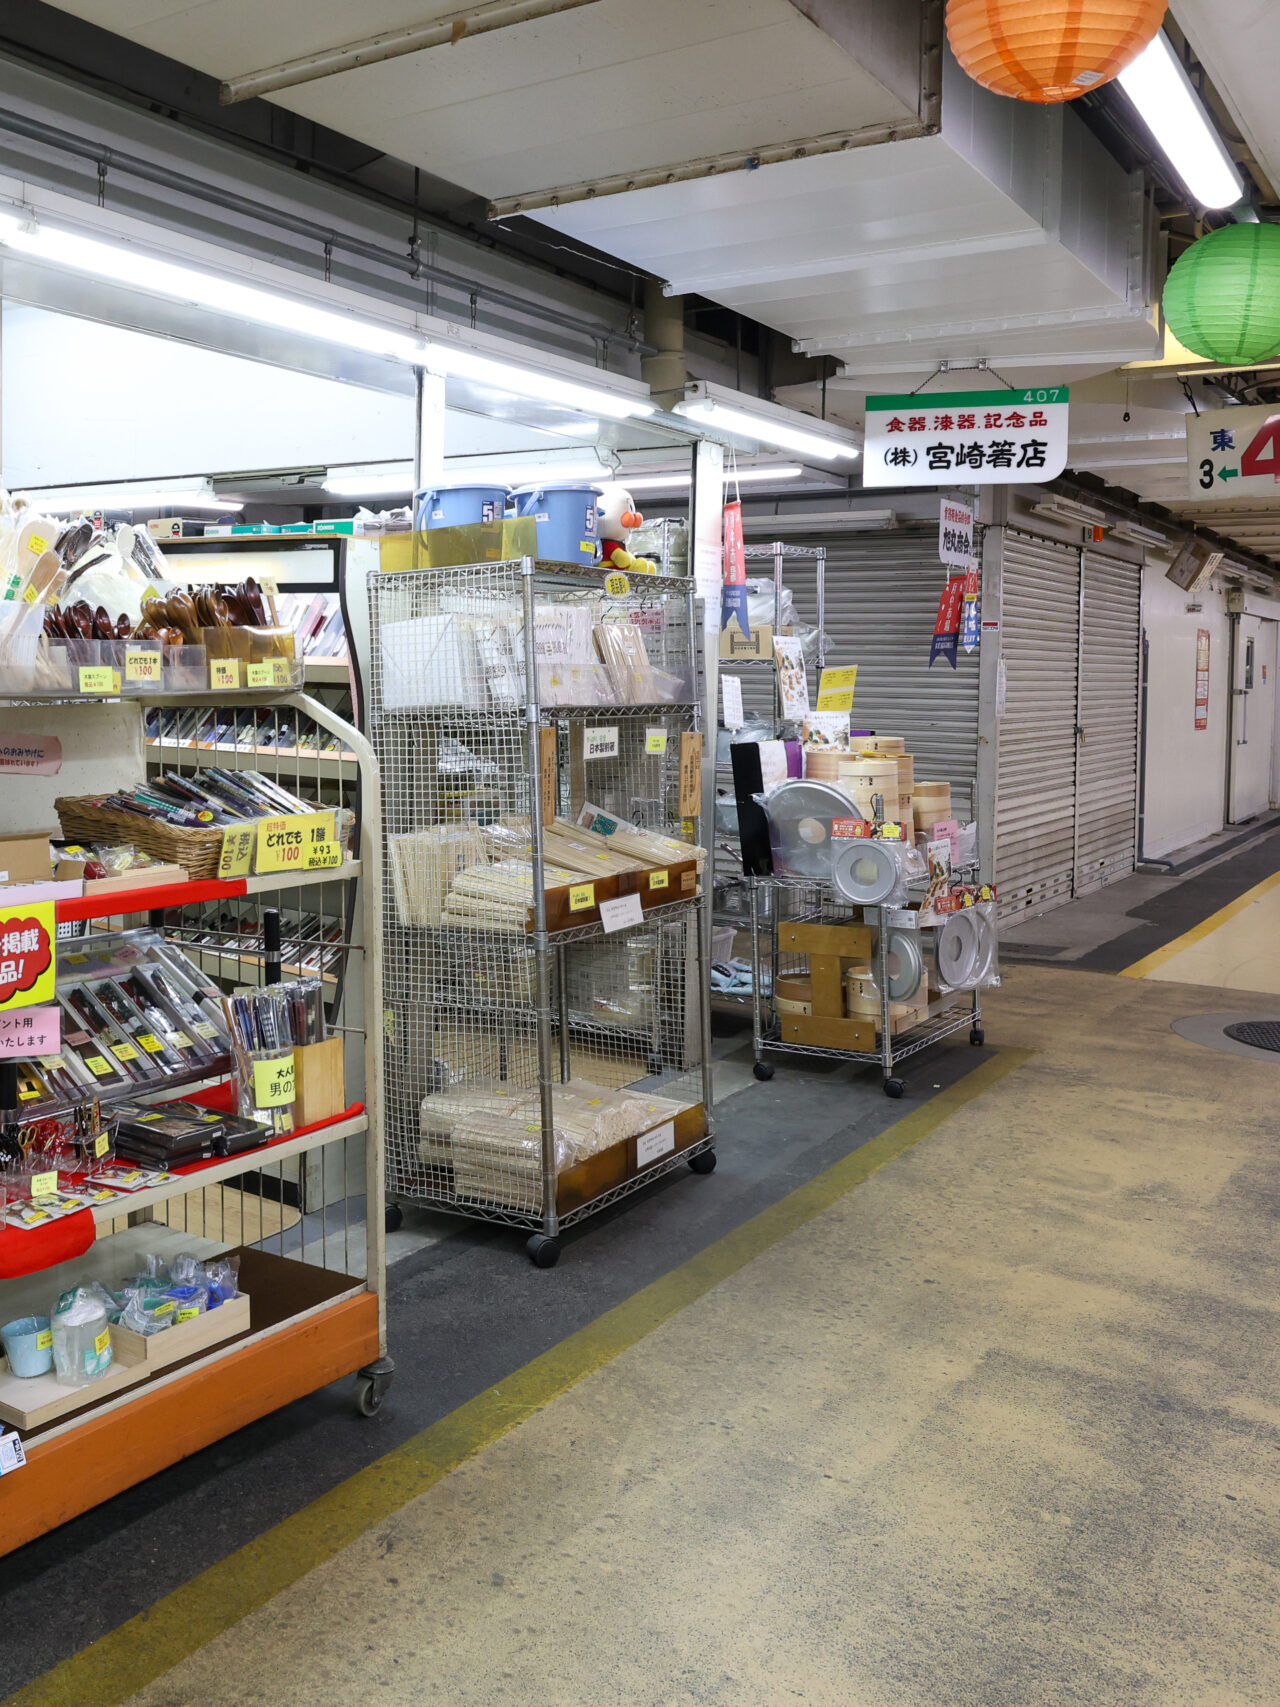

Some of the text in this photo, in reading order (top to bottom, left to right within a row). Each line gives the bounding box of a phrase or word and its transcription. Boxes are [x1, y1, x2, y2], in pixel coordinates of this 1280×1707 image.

[1023, 389, 1060, 403] 407
[1209, 428, 1237, 452] 東
[1199, 458, 1215, 490] 3
[482, 505, 494, 522] 5
[585, 509, 594, 529] 5
[266, 831, 303, 848] どれでも
[221, 834, 238, 871] ¥100
[313, 845, 331, 855] ¥93
